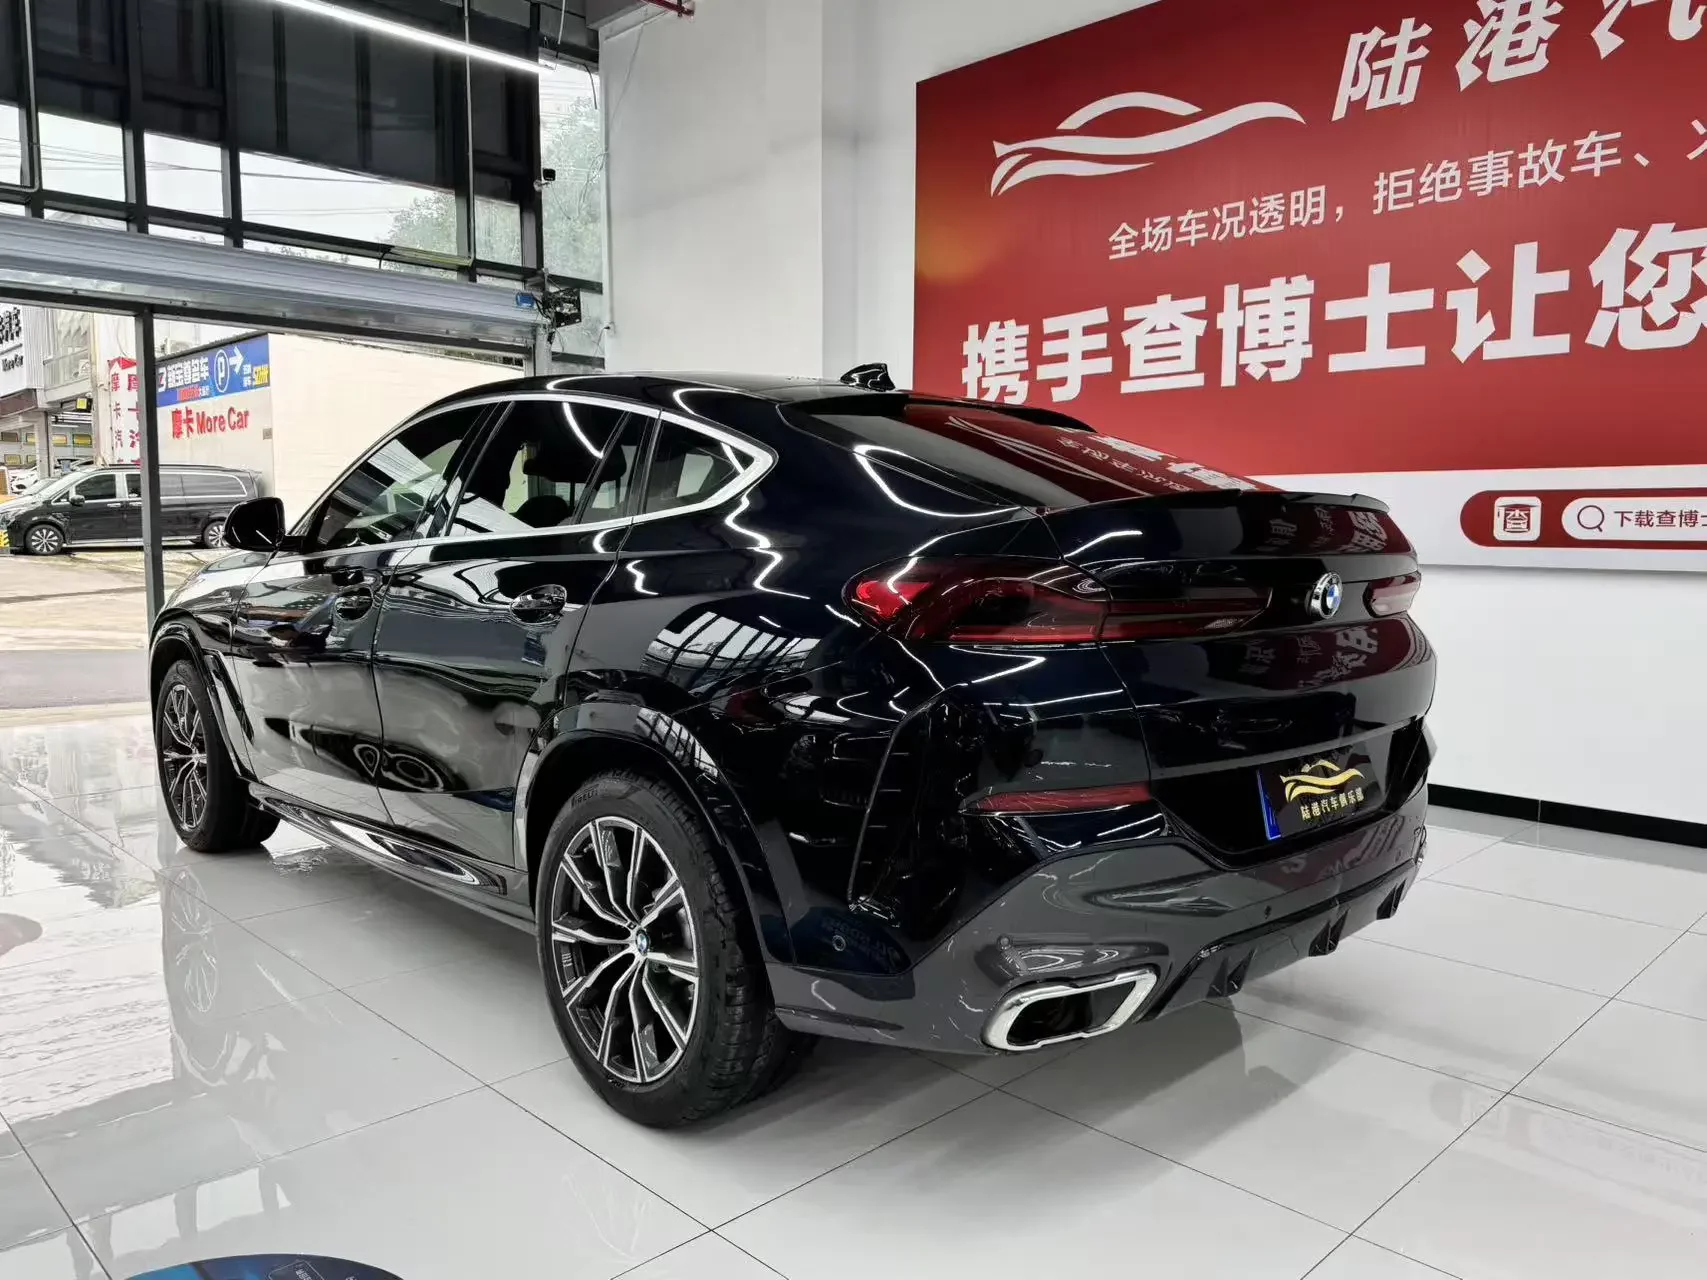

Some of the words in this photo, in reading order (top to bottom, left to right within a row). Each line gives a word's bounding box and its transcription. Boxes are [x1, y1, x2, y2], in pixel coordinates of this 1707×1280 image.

[961, 221, 1707, 404] 携手查博士让您
[171, 405, 195, 440] 摩卡
[196, 411, 227, 435] More
[228, 406, 251, 431] Car
